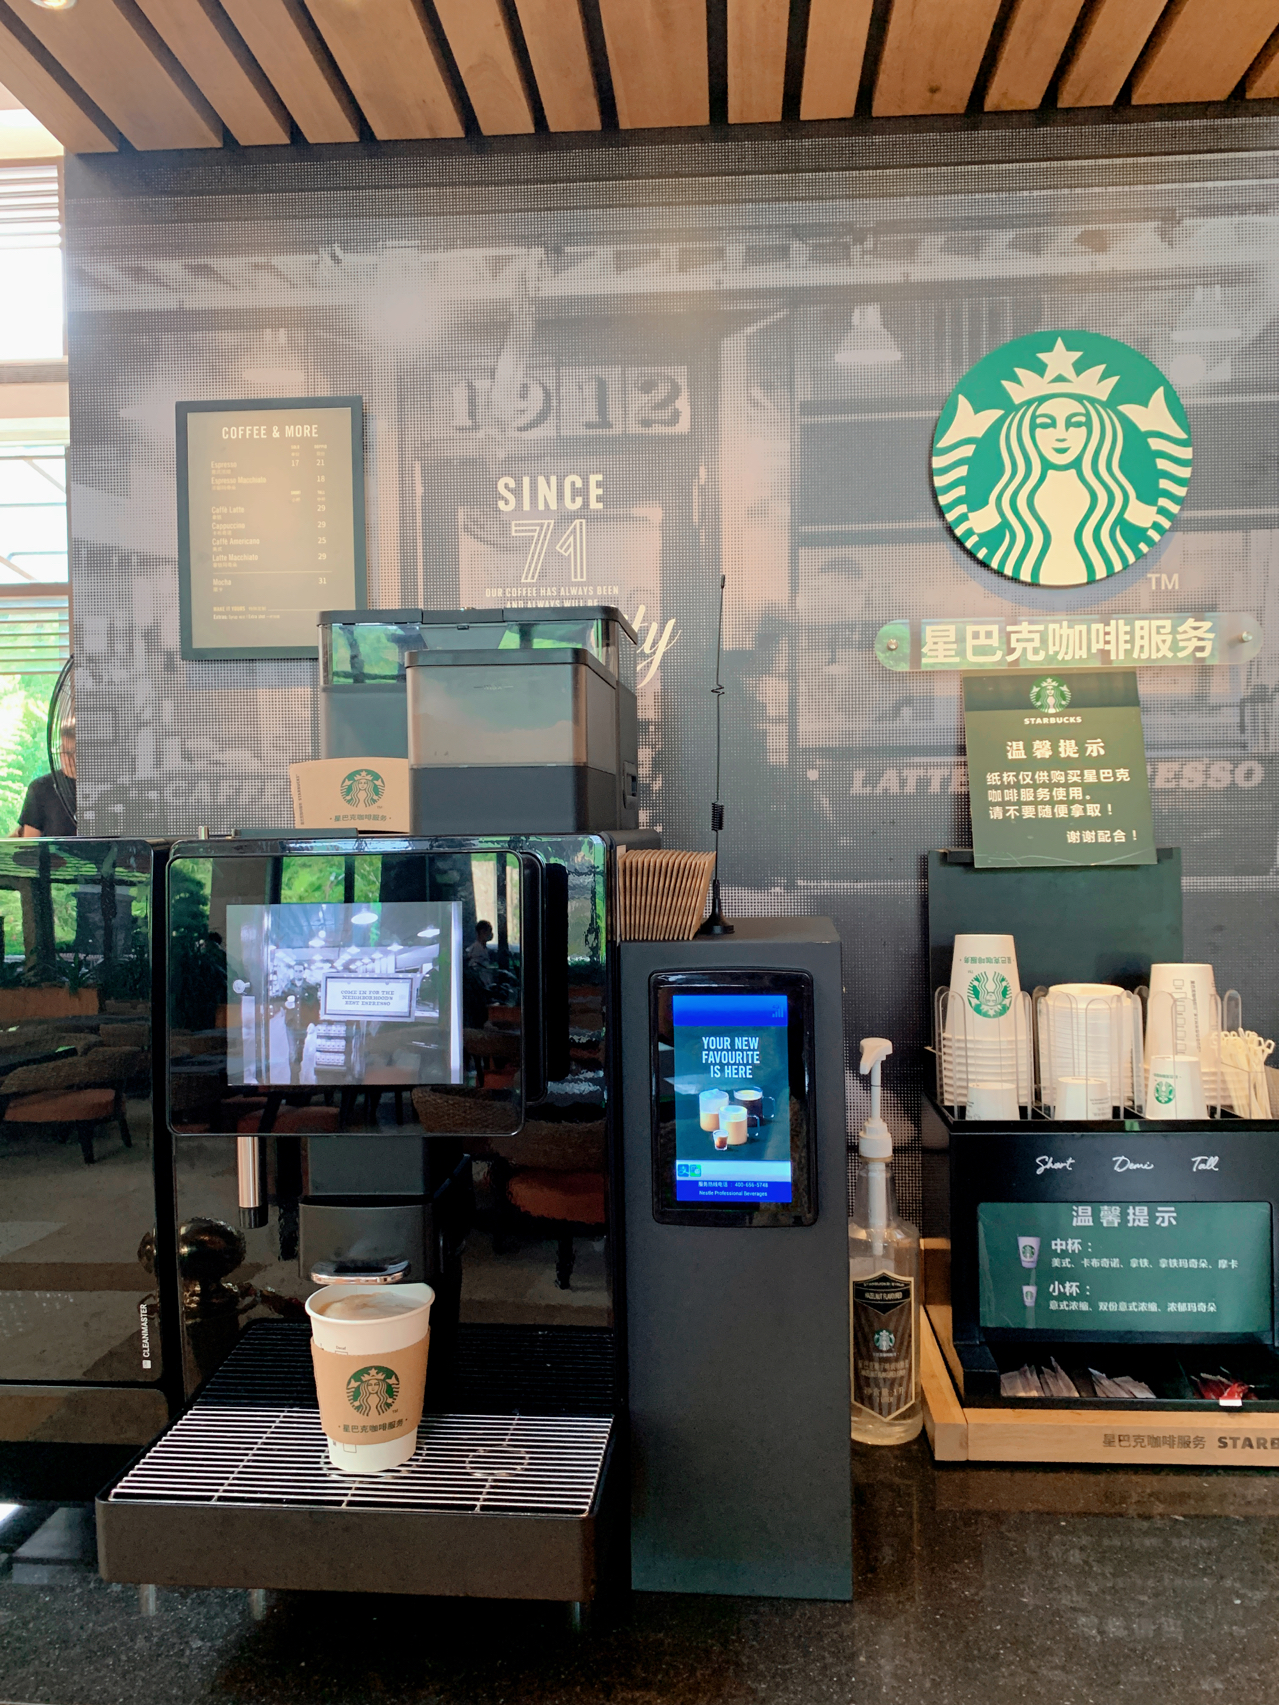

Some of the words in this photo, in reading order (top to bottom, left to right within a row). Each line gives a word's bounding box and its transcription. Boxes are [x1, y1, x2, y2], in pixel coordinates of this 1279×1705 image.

[222, 426, 267, 439] COFFEE
[272, 425, 280, 438] &
[285, 424, 318, 438] MORE
[211, 461, 238, 469] Espresso
[498, 474, 604, 512] SINCE
[212, 522, 246, 530] Cappuccino
[511, 519, 586, 582] 71
[486, 588, 503, 598] OUR
[506, 587, 537, 597] COFFEE
[540, 586, 557, 596] HAS
[560, 586, 594, 596] ALWAYS
[597, 586, 619, 595] BEEN
[528, 600, 560, 608] ALWAYS
[921, 618, 1216, 664] 星巴克咖啡服务
[1024, 716, 1082, 724] STARBUCKS
[1006, 738, 1106, 759] 温馨提示
[986, 768, 1131, 786] 纸杯仅供购买星巴克
[987, 786, 1091, 802] 咖啡服务使用。
[989, 804, 1112, 820] 请不要随便拿取！
[1066, 830, 1138, 844] 谢谢配合！
[702, 1036, 731, 1050] YOUR
[734, 1036, 760, 1050] NEW
[702, 1051, 760, 1064] FAVOURITE
[710, 1065, 720, 1078] IS
[724, 1065, 752, 1078] HERE
[1036, 1156, 1076, 1174] Short
[1191, 1156, 1220, 1172] Tall
[1072, 1205, 1177, 1227] 温馨提示
[140, 1304, 150, 1358] CLEANMASTER
[343, 1419, 404, 1434] 星巴克咖啡服务
[1102, 1434, 1206, 1449] 星巴克咖啡服务
[1218, 1436, 1279, 1450] STARB
